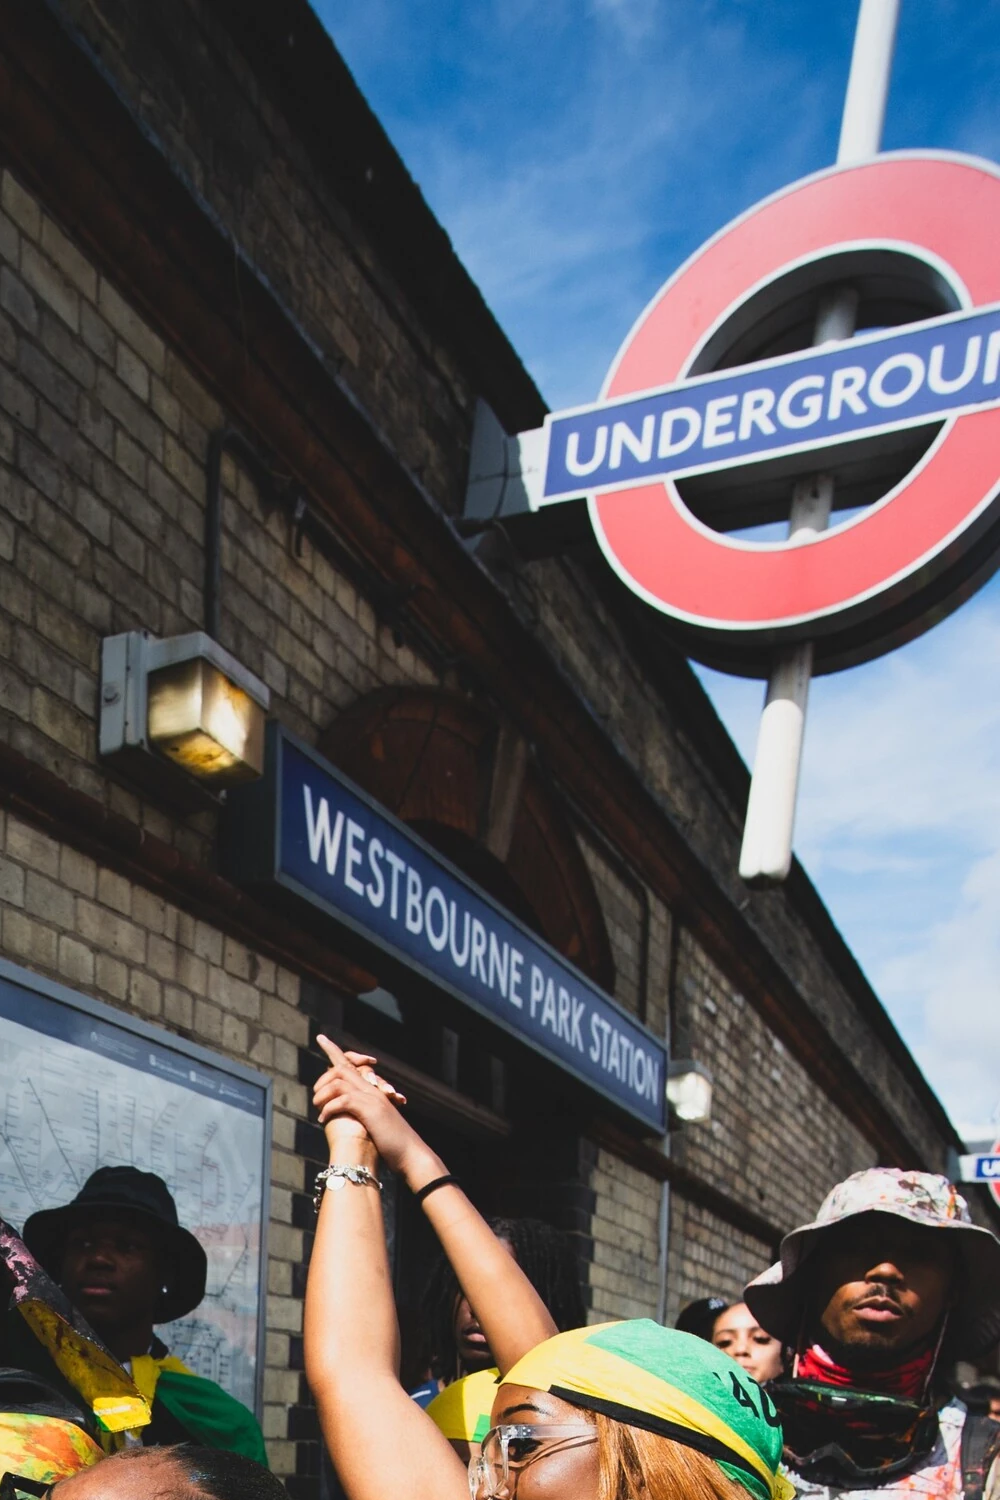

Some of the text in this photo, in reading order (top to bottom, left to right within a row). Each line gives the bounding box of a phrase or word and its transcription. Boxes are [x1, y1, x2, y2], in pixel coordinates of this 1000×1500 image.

[304, 784, 658, 1105] WESTBOURNE PARK STATION
